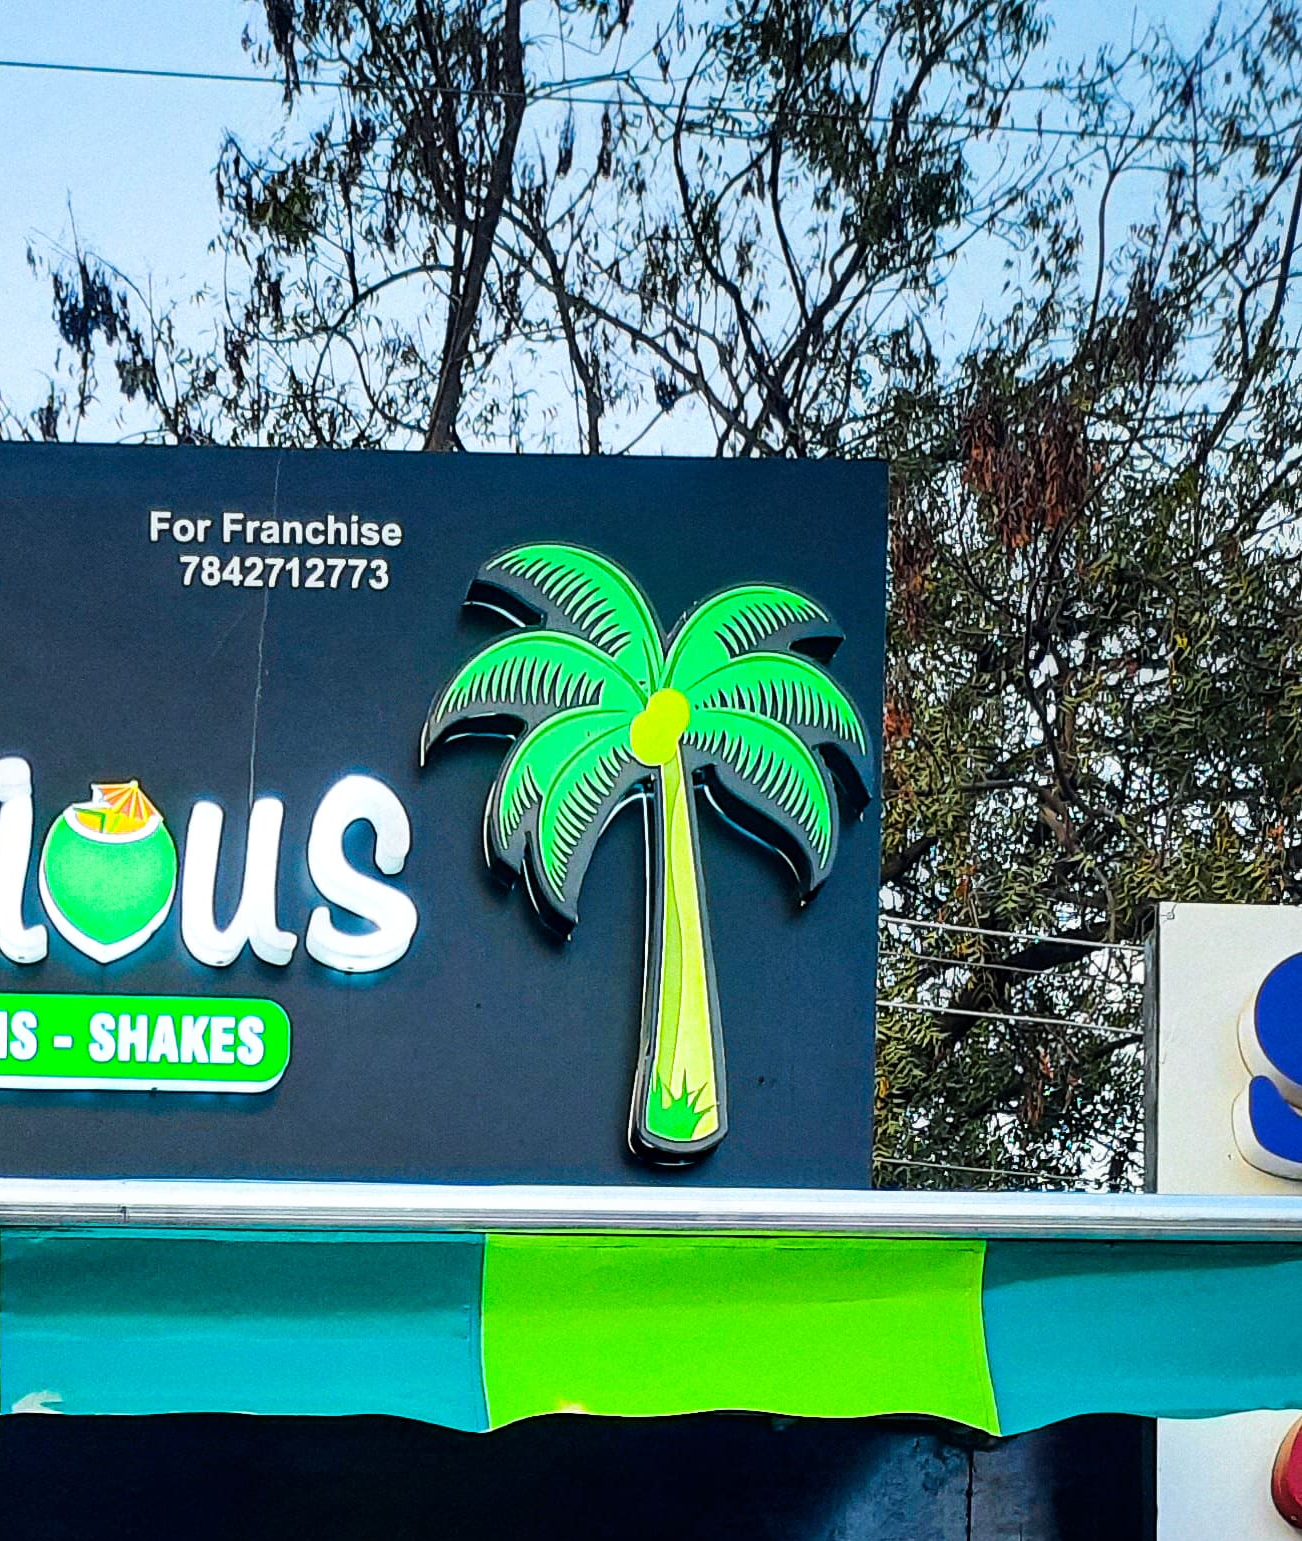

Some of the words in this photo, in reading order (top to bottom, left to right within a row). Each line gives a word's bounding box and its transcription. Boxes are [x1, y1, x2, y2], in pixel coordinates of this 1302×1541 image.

[149, 510, 212, 543] For
[222, 511, 403, 547] Franchise
[179, 554, 390, 591] 7842712773
[87, 1012, 265, 1067] SHAKES
